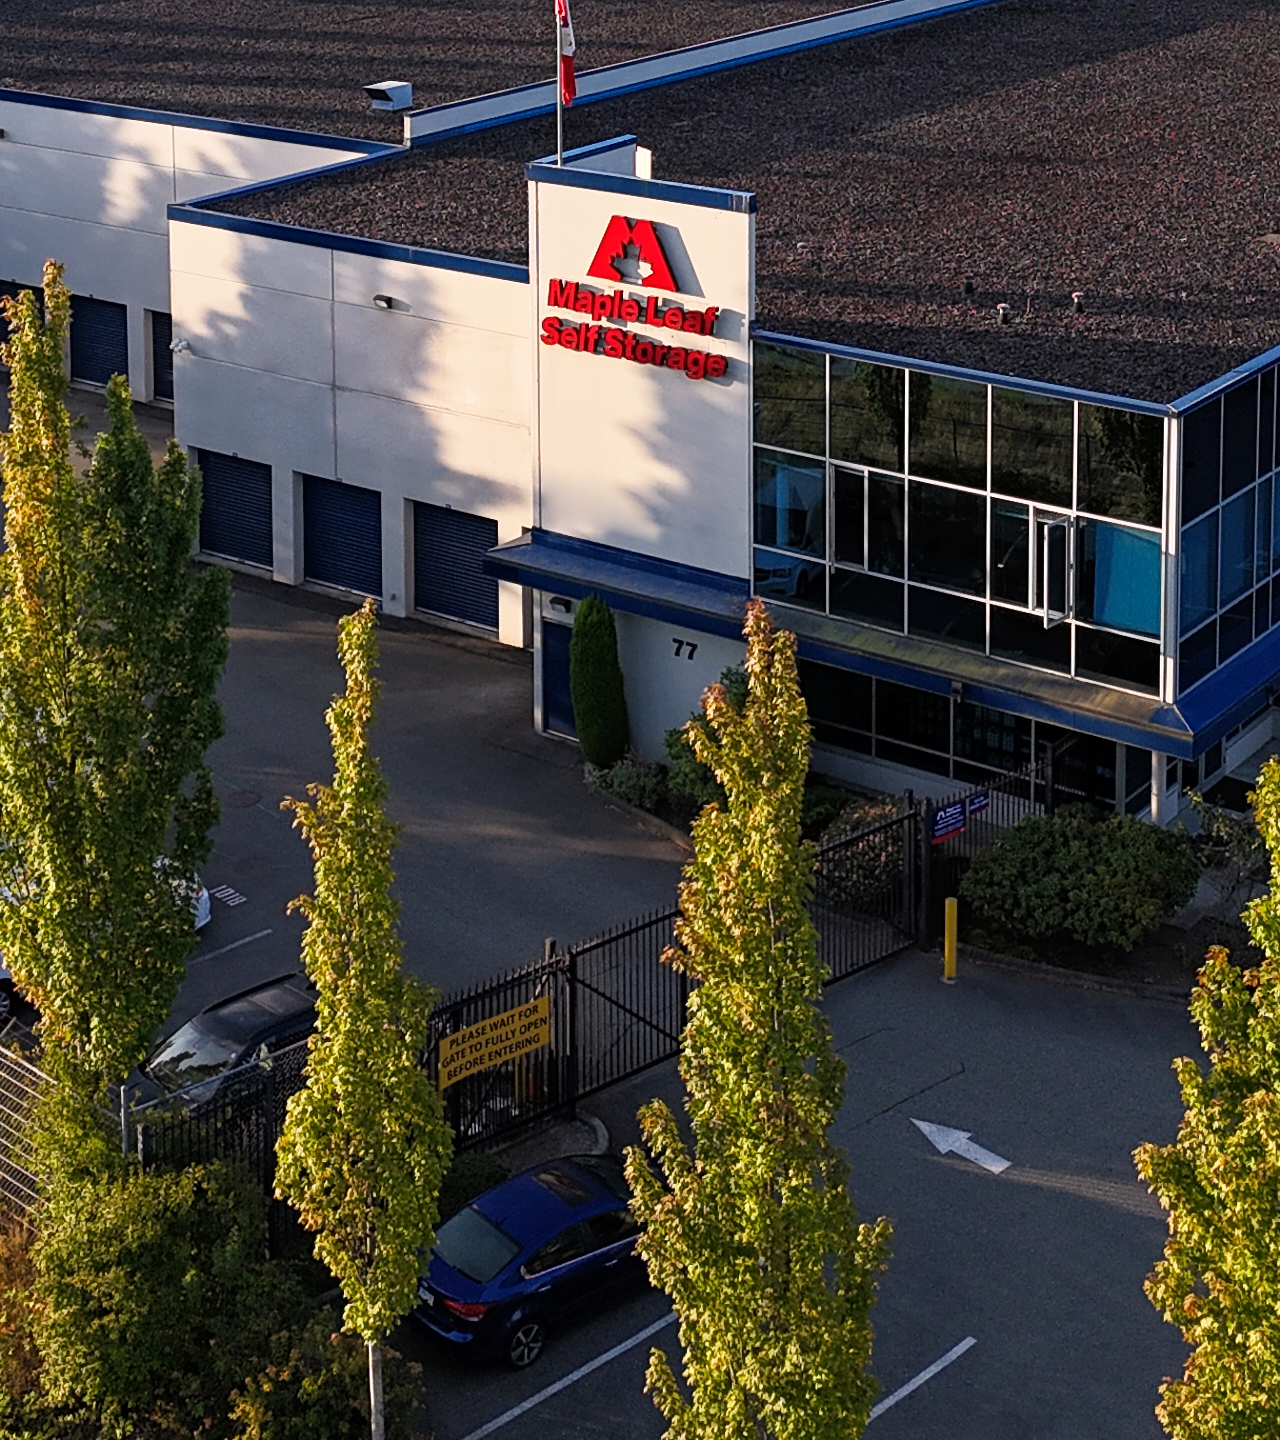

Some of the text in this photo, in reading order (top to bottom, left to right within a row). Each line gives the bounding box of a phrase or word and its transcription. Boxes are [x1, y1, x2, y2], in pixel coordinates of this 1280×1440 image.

[547, 278, 719, 336] Maple Leaf
[540, 316, 728, 379] Self Storage
[672, 638, 698, 660] 77
[442, 1016, 548, 1069] GATE TO FULLY OPEN
[449, 1004, 539, 1049] PLEASE WAIT FOR
[447, 1033, 540, 1081] BEFORE ENTERING
